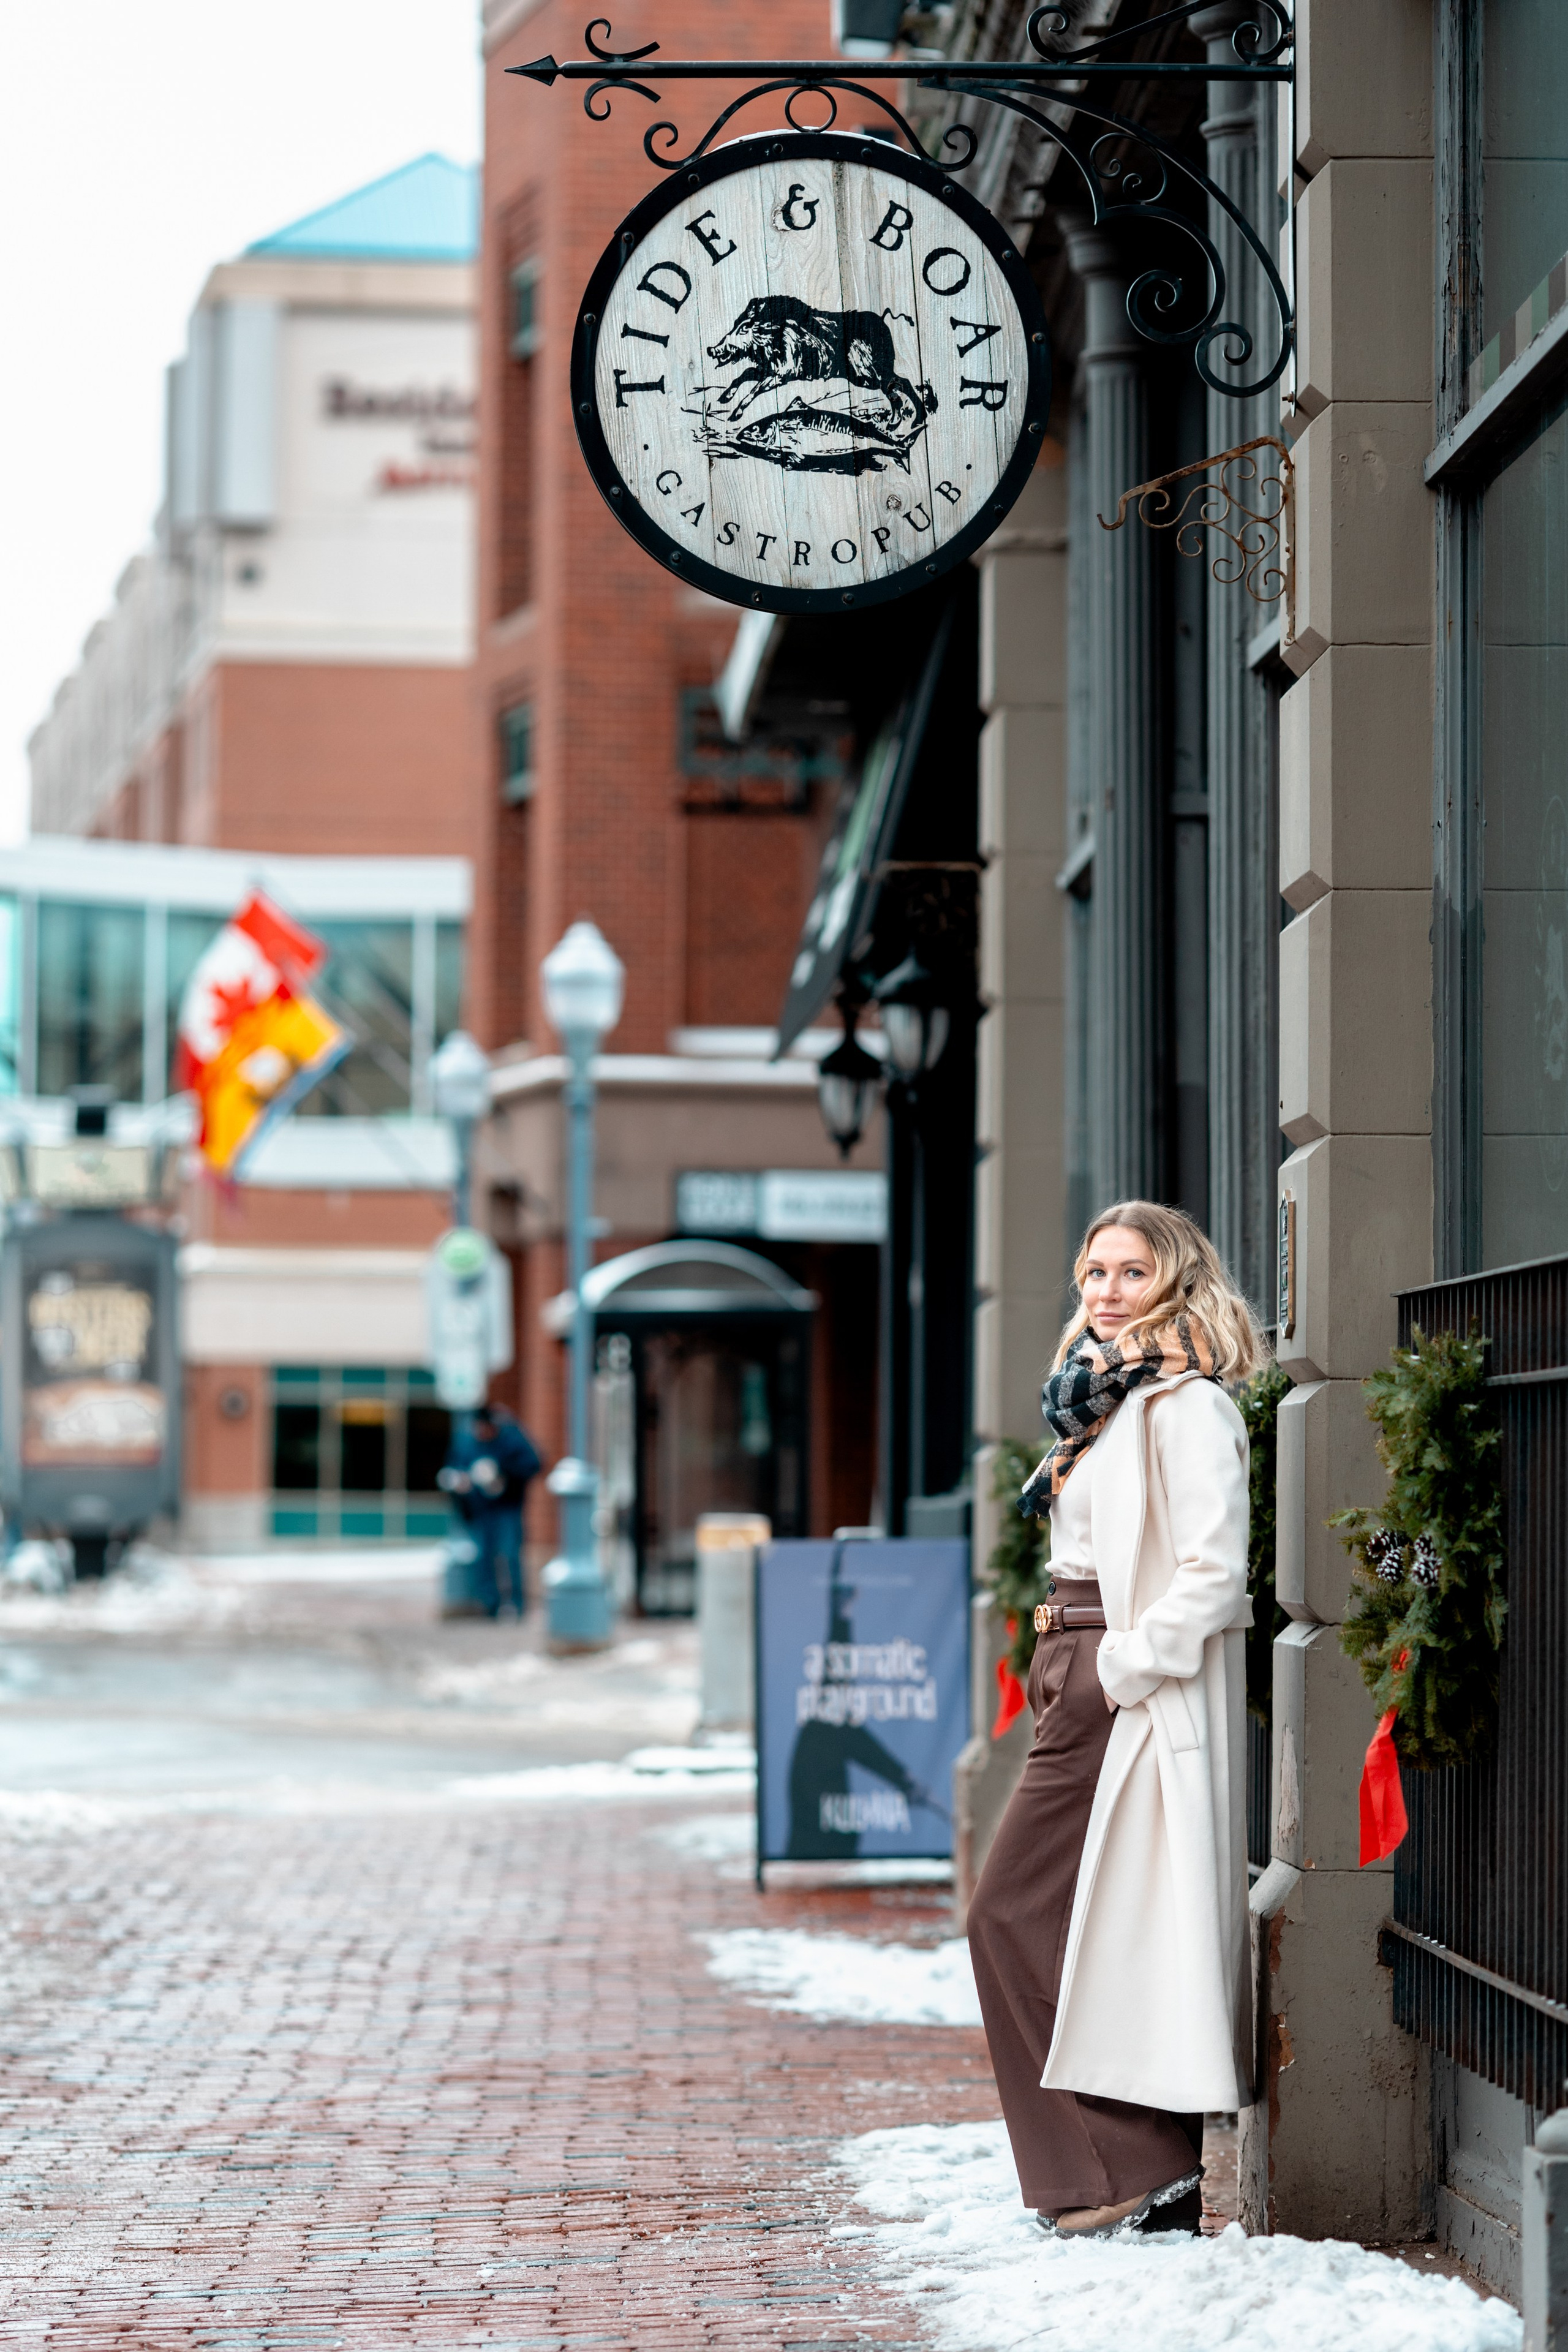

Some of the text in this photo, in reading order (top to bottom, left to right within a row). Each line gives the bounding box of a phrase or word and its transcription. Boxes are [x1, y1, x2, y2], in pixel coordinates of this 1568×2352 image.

[613, 183, 1009, 417] TIDE & BOAR
[655, 469, 962, 566] GASTROPUB
